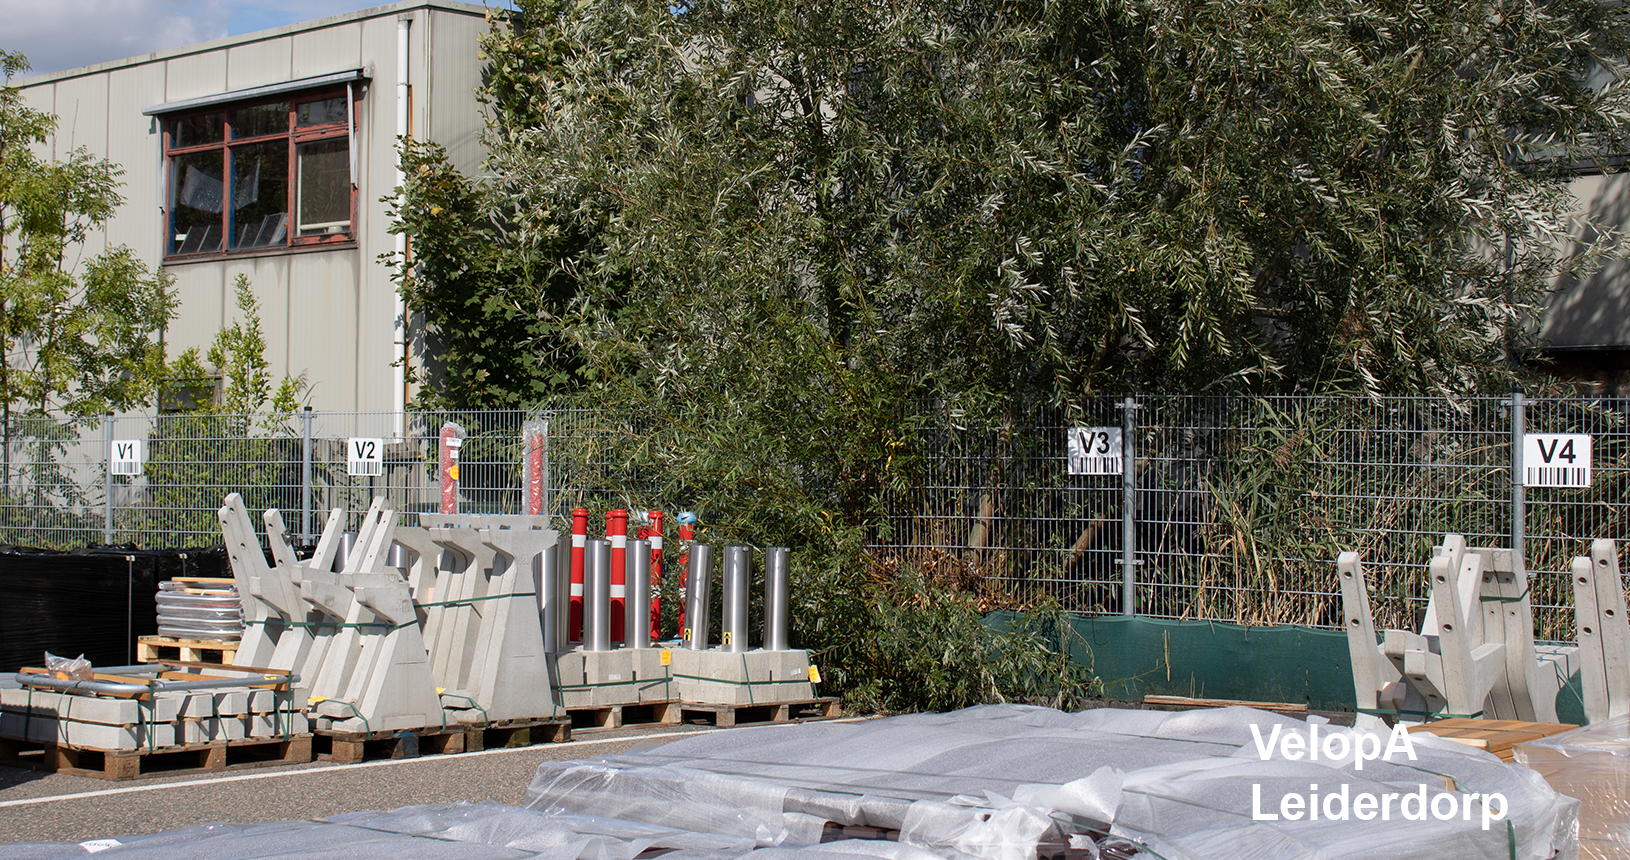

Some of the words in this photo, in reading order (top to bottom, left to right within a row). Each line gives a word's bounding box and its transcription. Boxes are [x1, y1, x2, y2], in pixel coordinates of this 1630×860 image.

[117, 443, 133, 460] V1
[355, 441, 375, 458] V2
[1078, 431, 1110, 454] V3
[1537, 438, 1576, 463] V4
